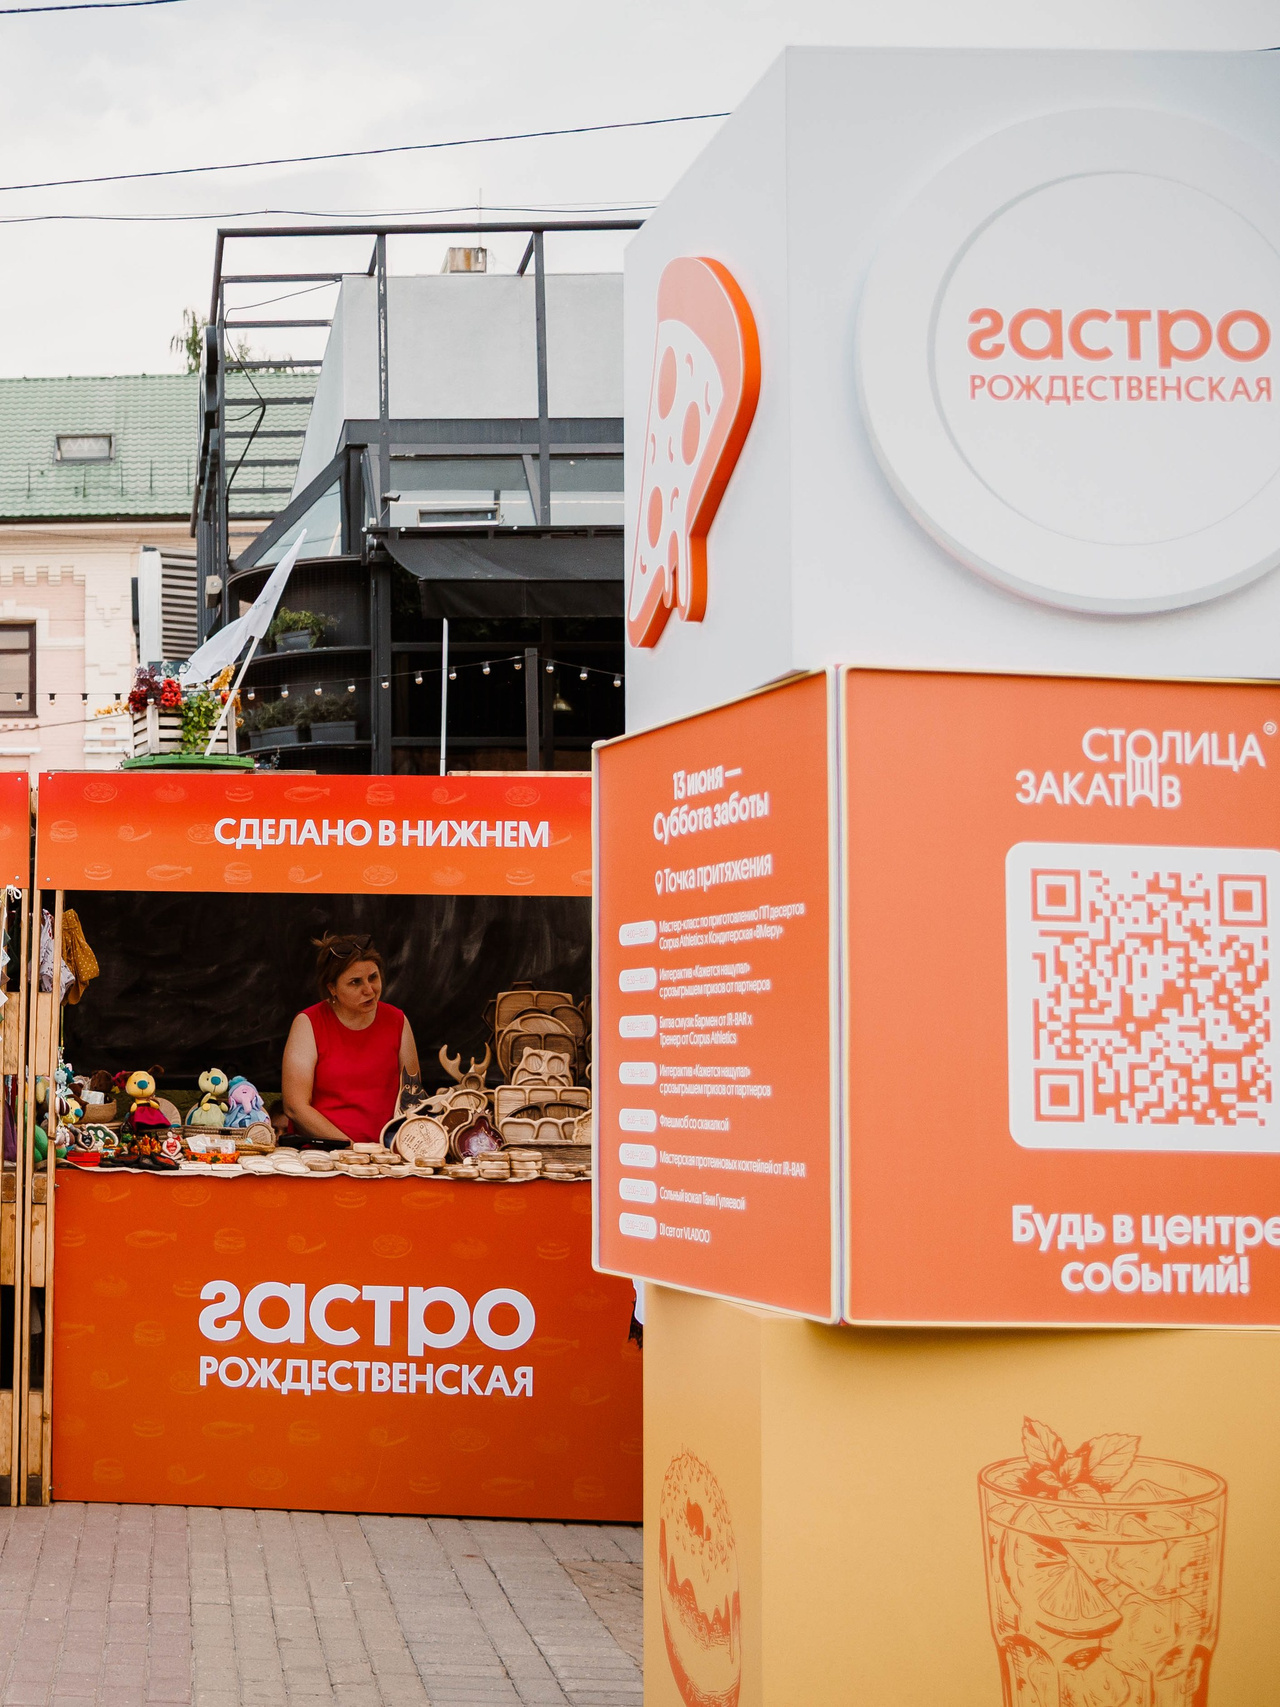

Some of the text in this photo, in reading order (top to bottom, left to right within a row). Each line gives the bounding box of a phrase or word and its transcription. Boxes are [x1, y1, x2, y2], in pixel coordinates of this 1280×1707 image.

[970, 374, 1272, 405] РОЖДЕСТВЕНСКАЯ
[673, 770, 685, 800] 13
[687, 765, 723, 796] июня
[653, 791, 769, 845] Суббота заботы
[213, 817, 549, 850] СДЕЛАНО В НИЖНЕМ
[664, 854, 772, 893] Точка притяжения
[659, 915, 700, 934] Мастер-класс
[708, 908, 759, 929] приготовлению
[770, 903, 805, 920] десертов
[659, 936, 680, 950] Corpus
[680, 934, 703, 947] Athletics
[708, 928, 753, 946] Кондитерская
[659, 967, 693, 983] Интерактив
[663, 984, 703, 999] розыгрышем
[703, 982, 726, 997] призов
[727, 983, 734, 993] от
[659, 1016, 674, 1029] Битва
[694, 1013, 718, 1030] Бармен
[718, 1015, 726, 1026] от
[659, 1030, 737, 1047] Тренер от Corpus Athletics
[659, 1064, 693, 1079] Интерактив
[663, 1083, 703, 1096] розыгрышем
[703, 1084, 726, 1097] призов
[727, 1084, 734, 1095] от
[659, 1114, 729, 1132] Флешмоб со скакалкой
[659, 1151, 694, 1167] Мастерская
[694, 1154, 737, 1171] протеиновых
[737, 1158, 773, 1175] коктейлей
[773, 1162, 782, 1175] от
[659, 1186, 685, 1201] Сольный
[685, 1191, 702, 1205] вокал
[1012, 1205, 1106, 1251] Будь
[1112, 1214, 1134, 1244] в
[1061, 1253, 1250, 1294] событий!
[199, 1355, 534, 1397] РОЖДЕСТВЕНСКАЯ
